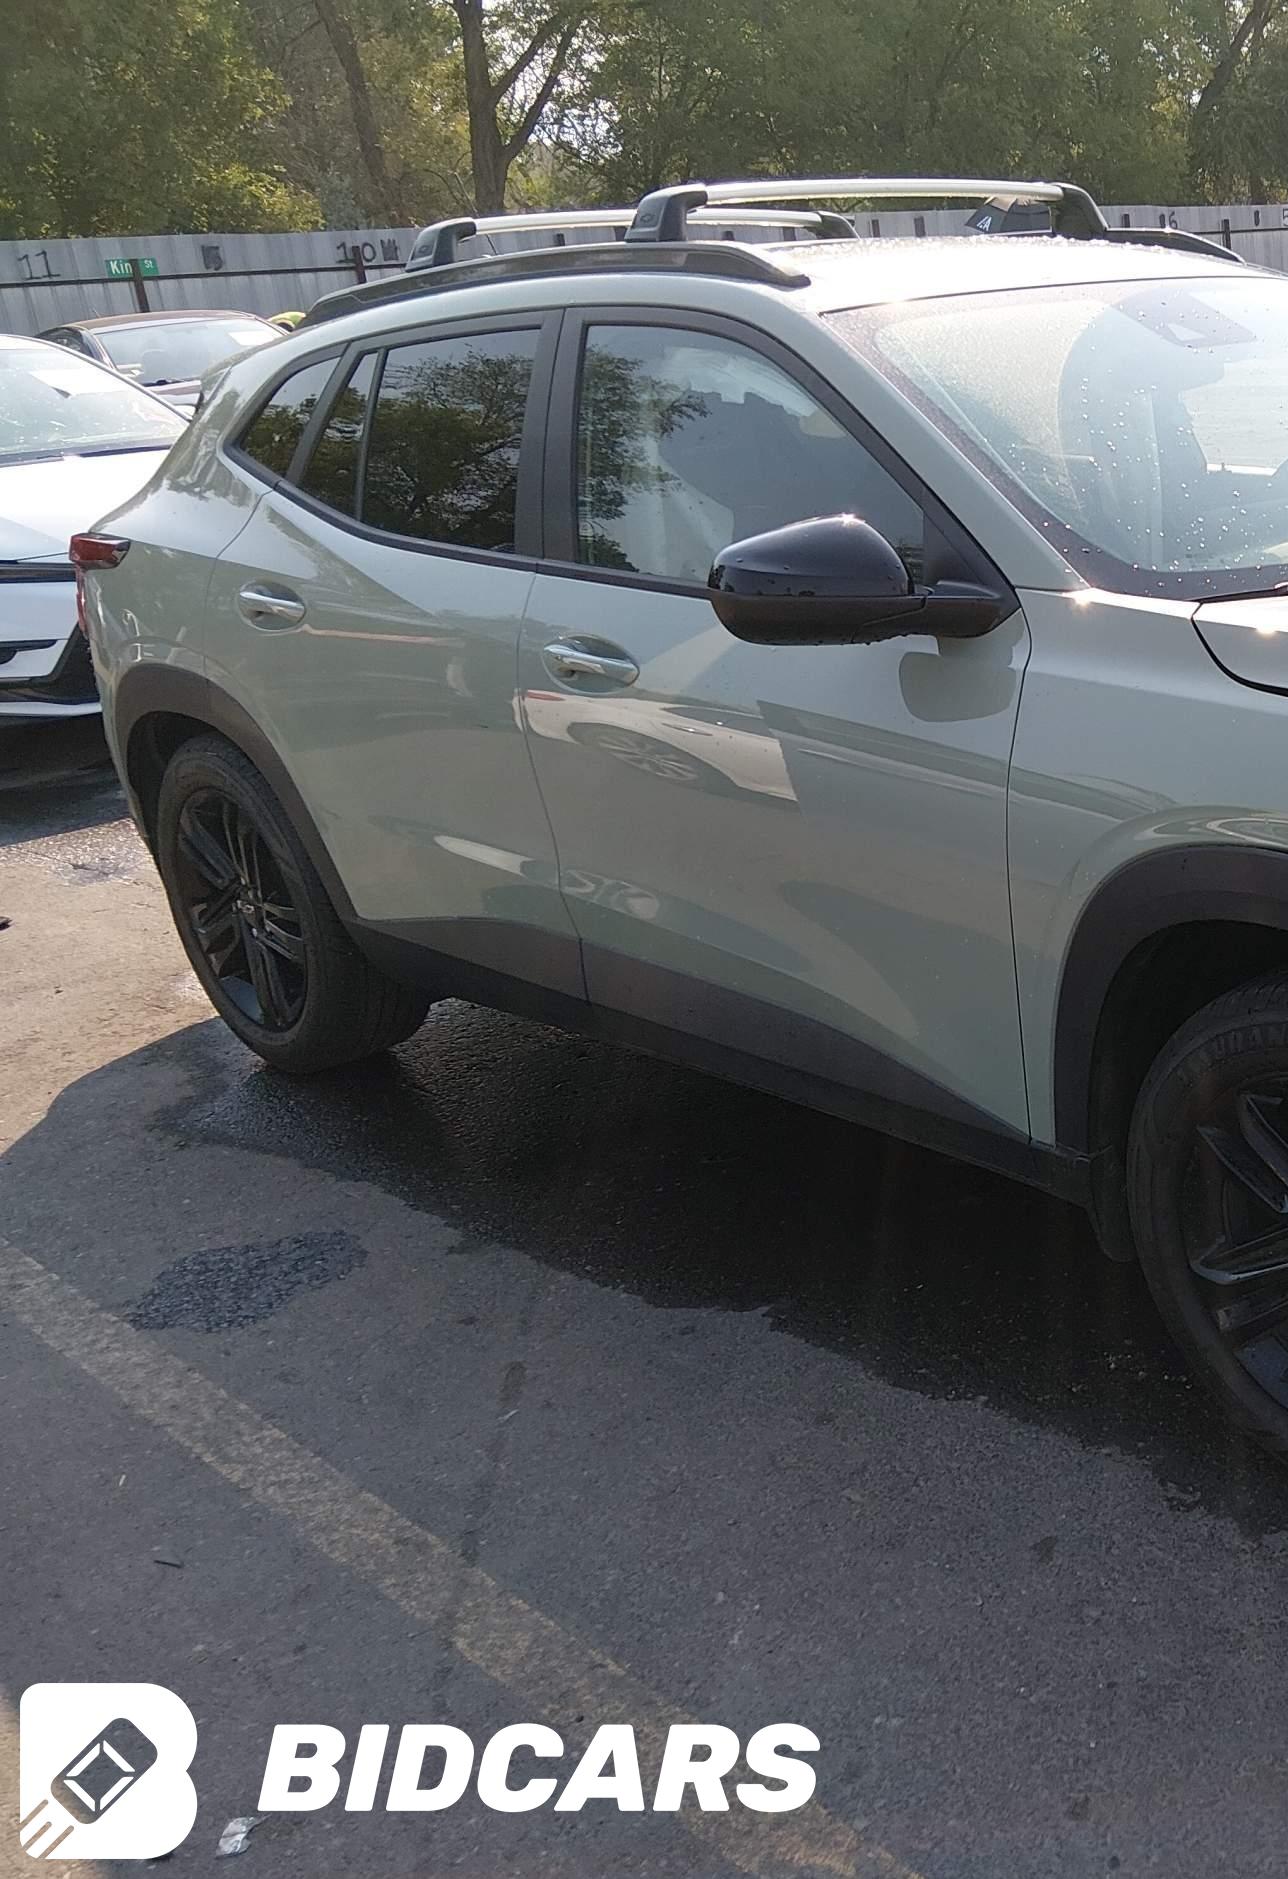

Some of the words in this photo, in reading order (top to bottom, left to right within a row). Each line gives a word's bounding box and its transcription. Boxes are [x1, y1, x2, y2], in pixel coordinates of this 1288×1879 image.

[1168, 211, 1178, 229] 6
[336, 242, 377, 264] 10
[17, 250, 61, 280] 11
[110, 260, 134, 275] Kin
[144, 260, 154, 269] St
